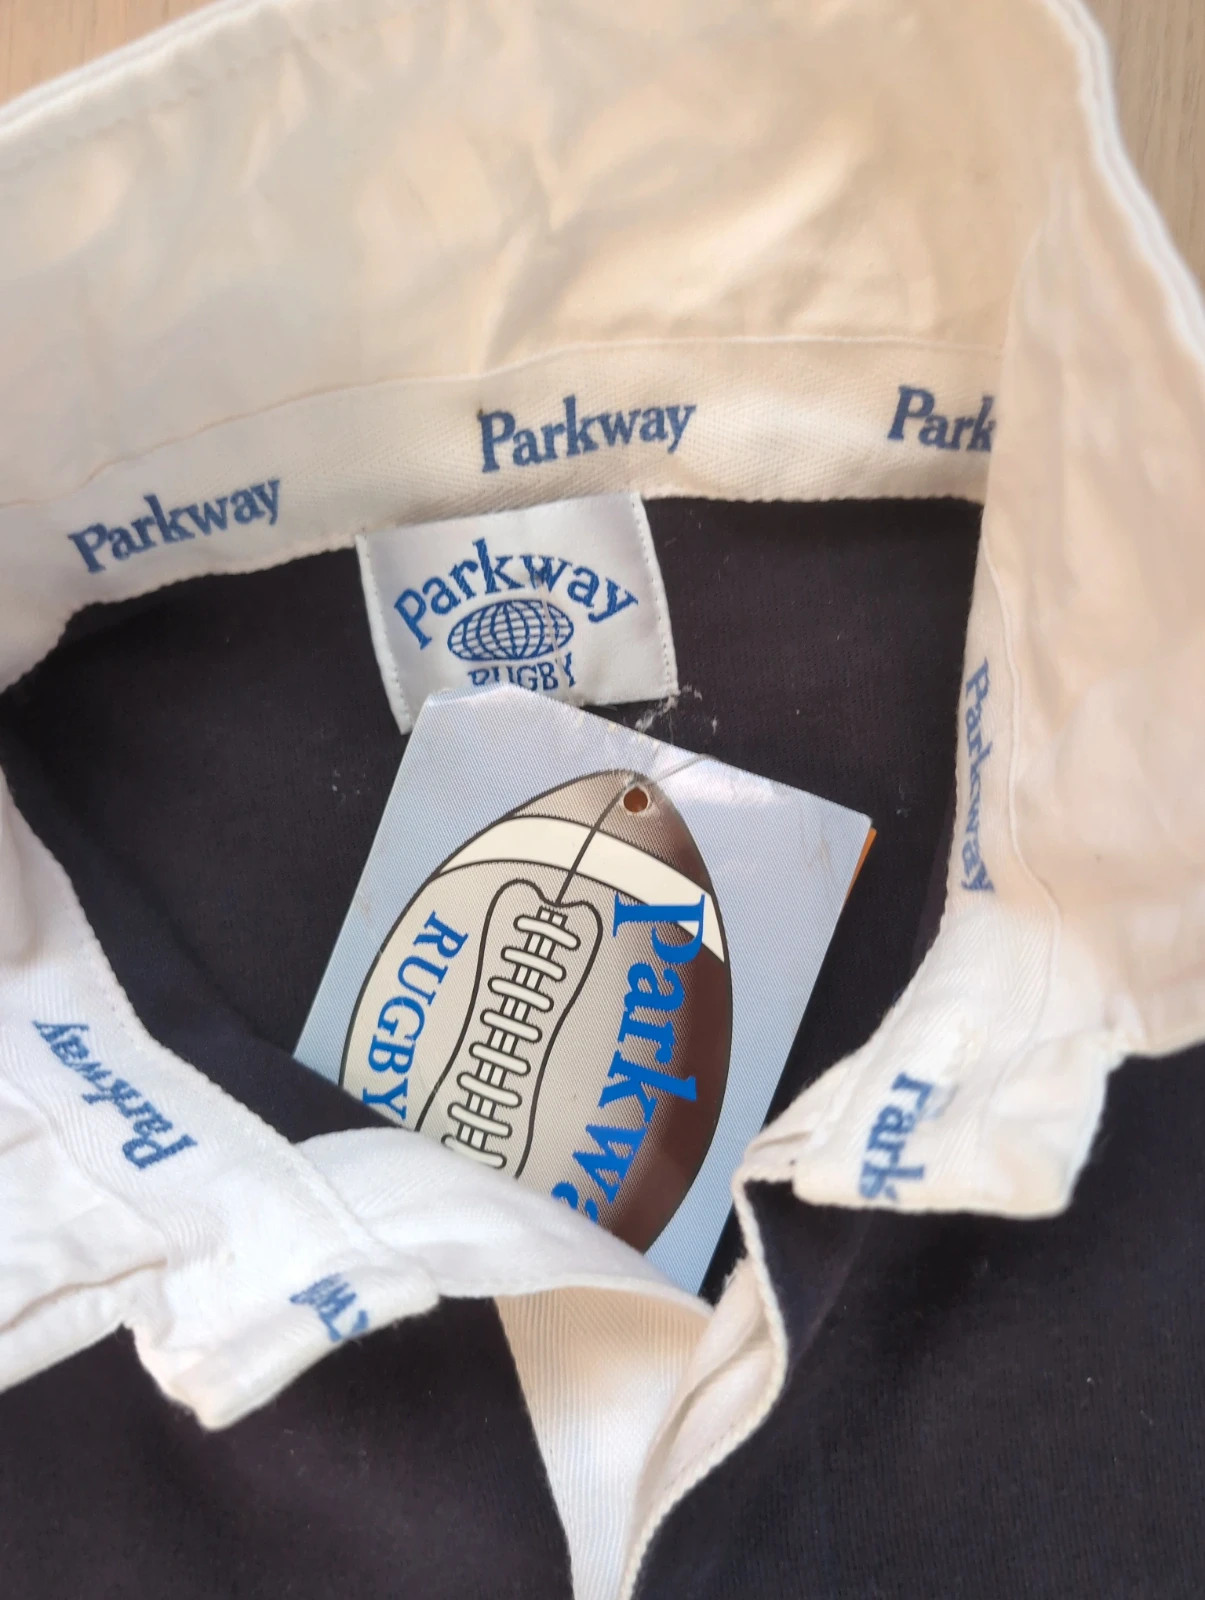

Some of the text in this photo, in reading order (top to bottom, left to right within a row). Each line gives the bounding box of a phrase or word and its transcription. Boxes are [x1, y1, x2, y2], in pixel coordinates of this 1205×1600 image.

[478, 395, 697, 474] Parkway
[887, 386, 996, 452] Park
[68, 479, 281, 574] Parkway
[393, 537, 639, 650] Parkway
[961, 656, 995, 892] Parkway
[362, 911, 468, 1120] RUGBY
[33, 1020, 198, 1170] Parkway
